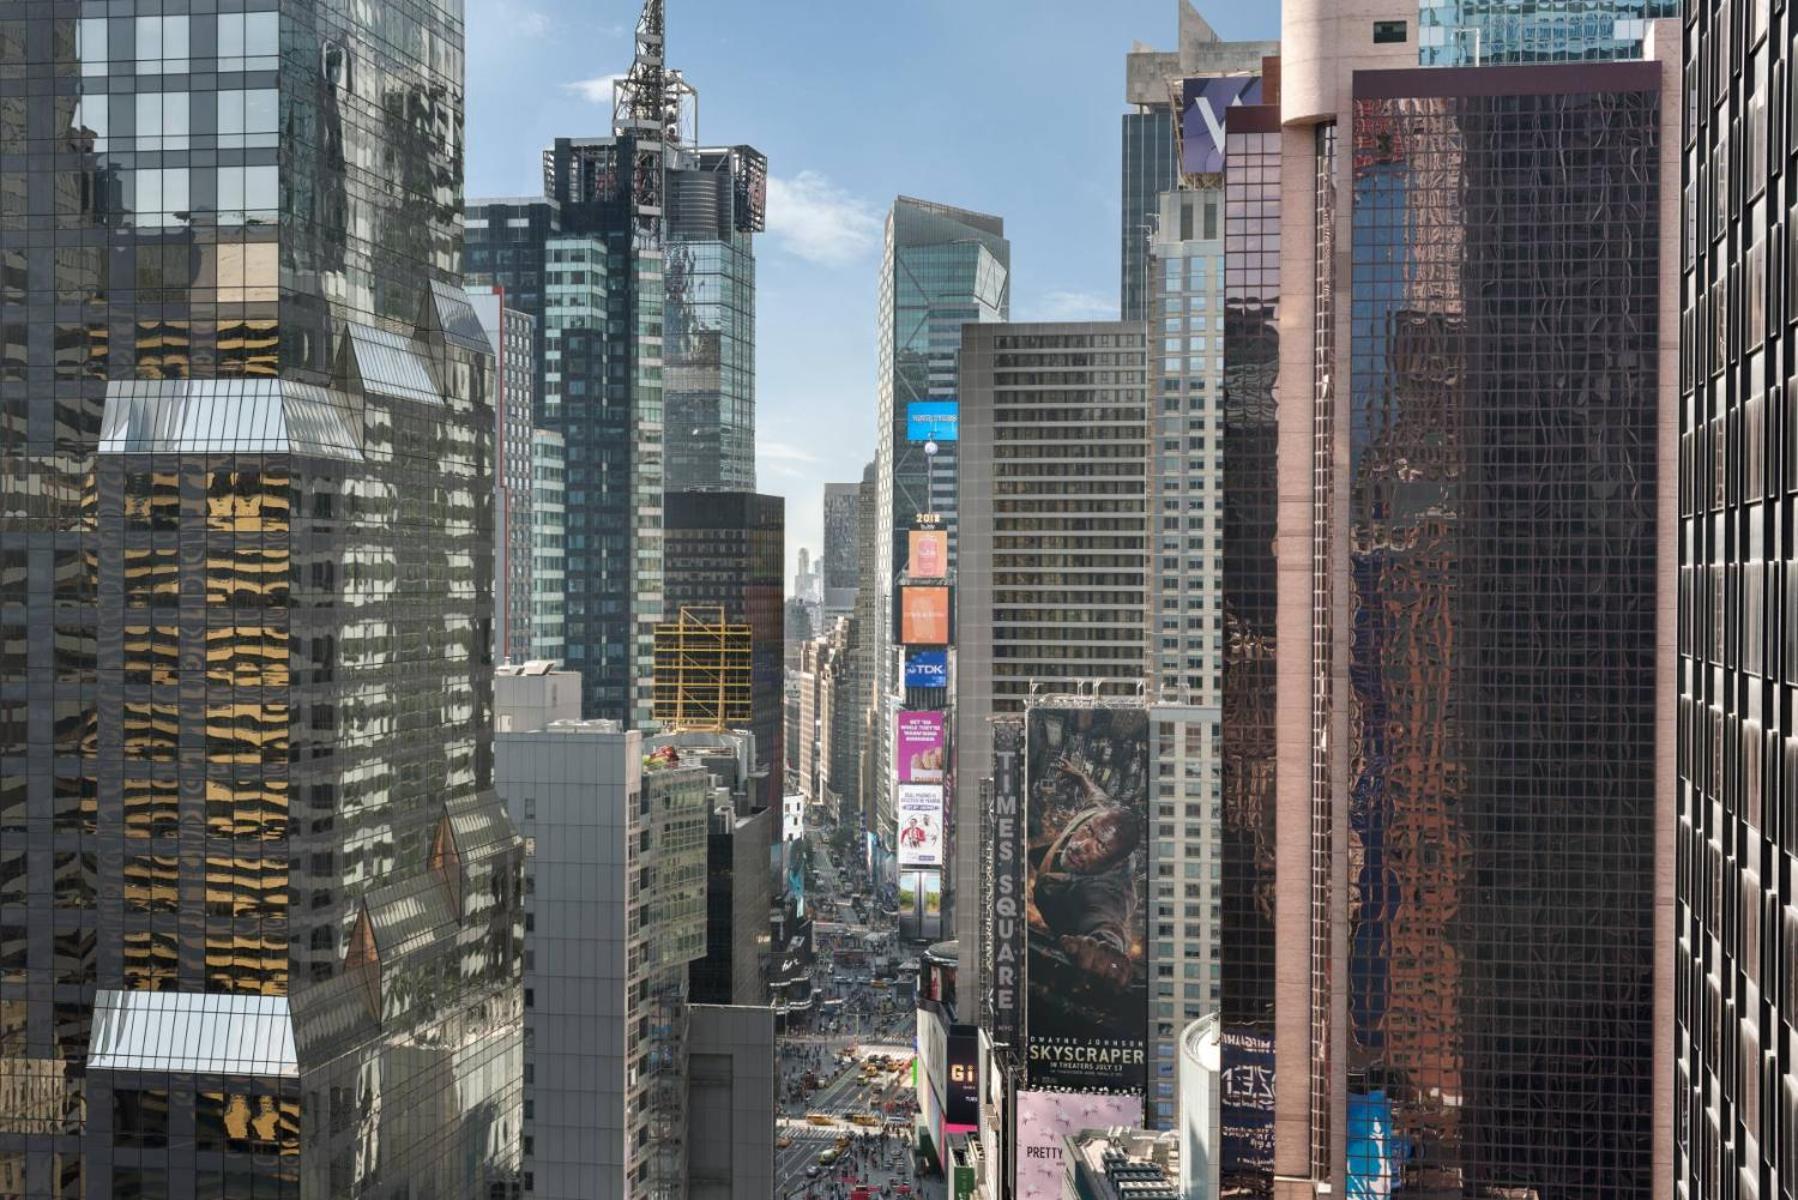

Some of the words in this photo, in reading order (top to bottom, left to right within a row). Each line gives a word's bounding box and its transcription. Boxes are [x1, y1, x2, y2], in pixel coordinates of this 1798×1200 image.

[916, 513, 940, 523] 2018
[916, 664, 943, 674] TDK
[996, 752, 1016, 861] TIMES
[996, 874, 1017, 1009] SQUARE
[1030, 1035, 1077, 1045] DWAYNE
[1087, 1038, 1143, 1048] JOHNSON
[1030, 1045, 1144, 1065] SKYSCRAPER
[1060, 1062, 1093, 1070] THEATERS
[1026, 1146, 1063, 1159] PRETTY
